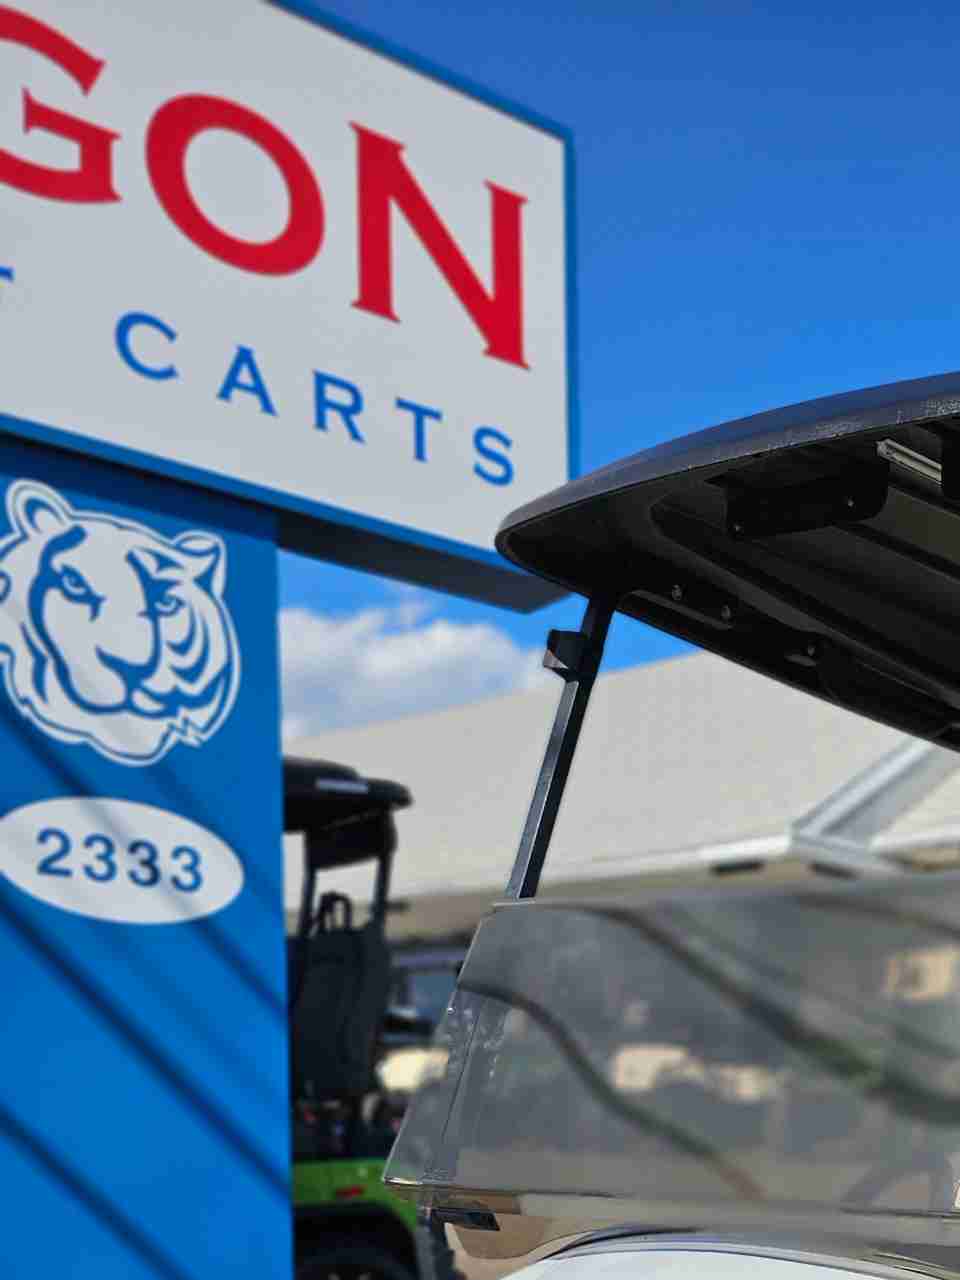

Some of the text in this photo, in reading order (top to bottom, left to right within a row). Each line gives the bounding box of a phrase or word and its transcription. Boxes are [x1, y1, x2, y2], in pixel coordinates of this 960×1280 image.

[0, 5, 530, 370] GON
[114, 311, 515, 487] CARTS
[36, 828, 205, 893] 2333
